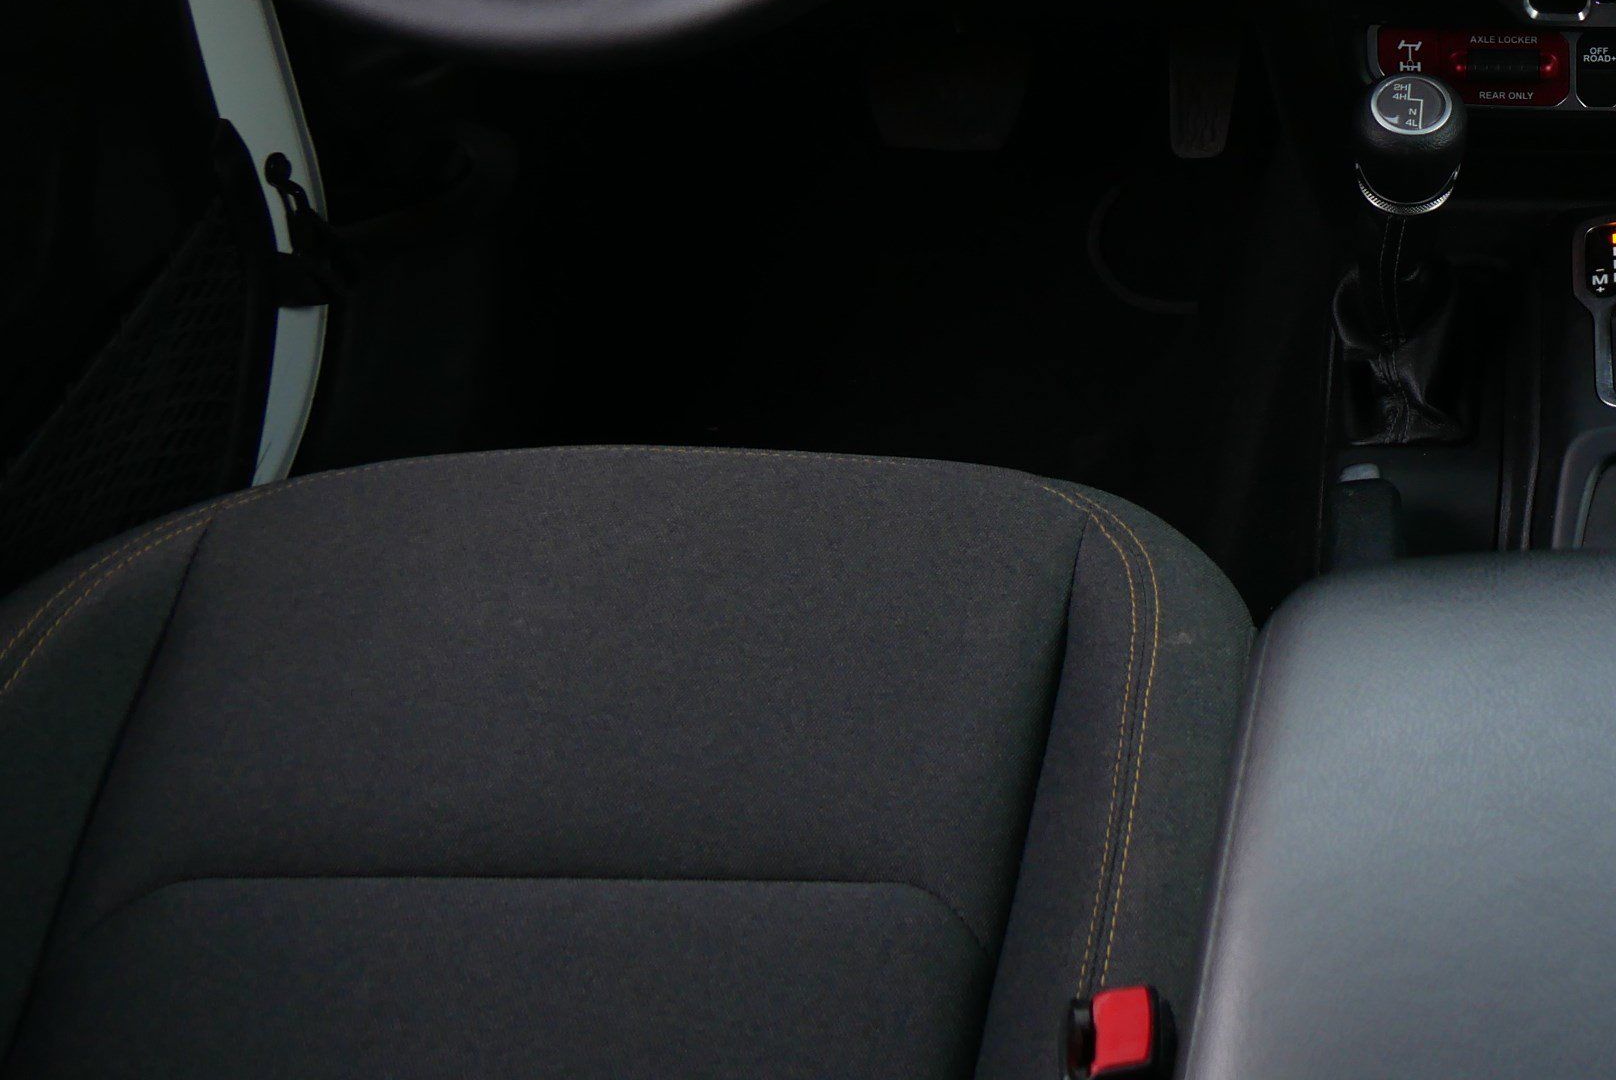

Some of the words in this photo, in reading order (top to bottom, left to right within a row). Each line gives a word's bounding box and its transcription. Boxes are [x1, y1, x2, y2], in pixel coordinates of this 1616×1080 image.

[1470, 35, 1496, 44] AXLE
[1498, 35, 1538, 44] LOCKER
[1589, 47, 1609, 55] OFF
[1583, 54, 1616, 63] ROAD+
[1393, 83, 1408, 91] 2H
[1392, 92, 1407, 100] 4H
[1479, 91, 1506, 100] REAR
[1508, 91, 1534, 100] ONLY
[1408, 108, 1417, 116] N
[1405, 118, 1418, 127] 4L
[1591, 274, 1608, 285] M
